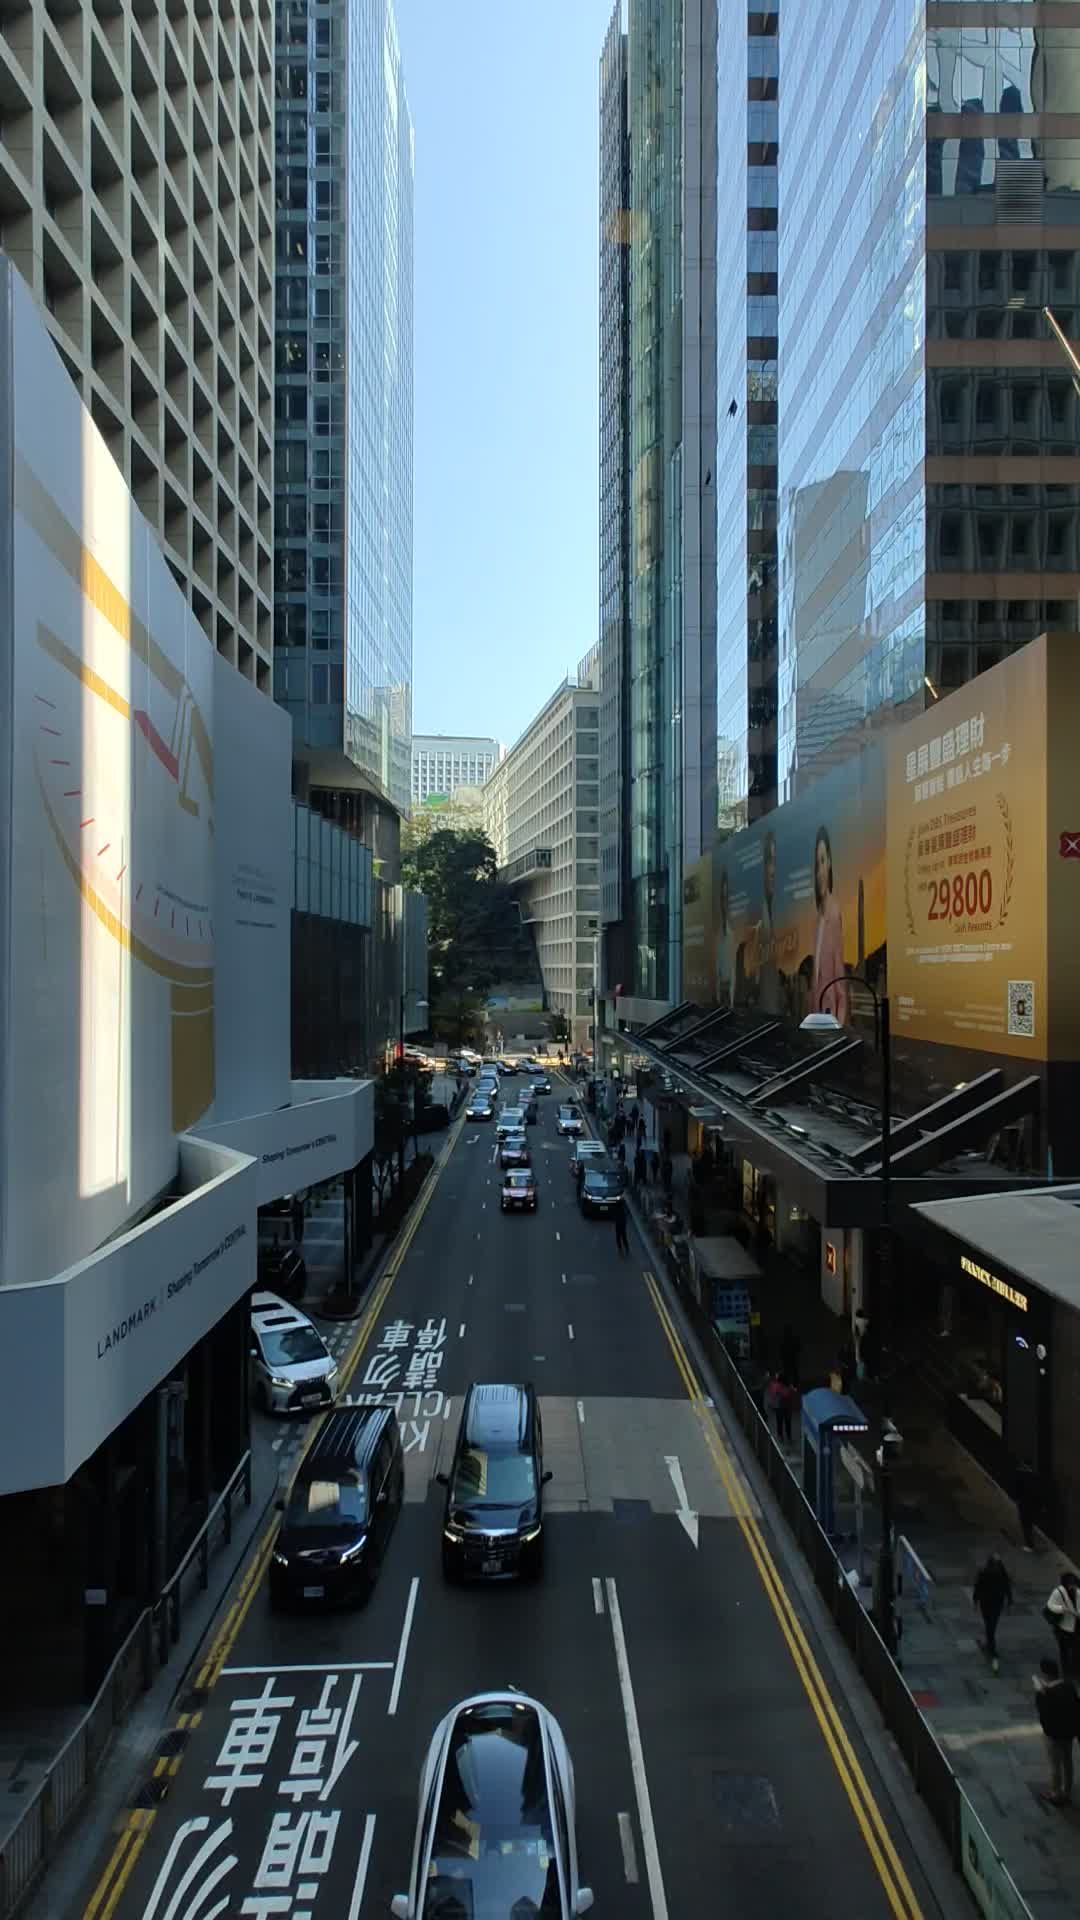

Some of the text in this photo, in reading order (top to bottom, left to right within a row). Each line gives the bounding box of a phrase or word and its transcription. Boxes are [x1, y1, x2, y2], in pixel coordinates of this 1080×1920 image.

[927, 868, 993, 924] 29,800
[97, 1297, 157, 1359] LANDMARK
[377, 1318, 447, 1352] 停車
[362, 1351, 444, 1391] 請勿
[203, 1673, 363, 1807] 停車
